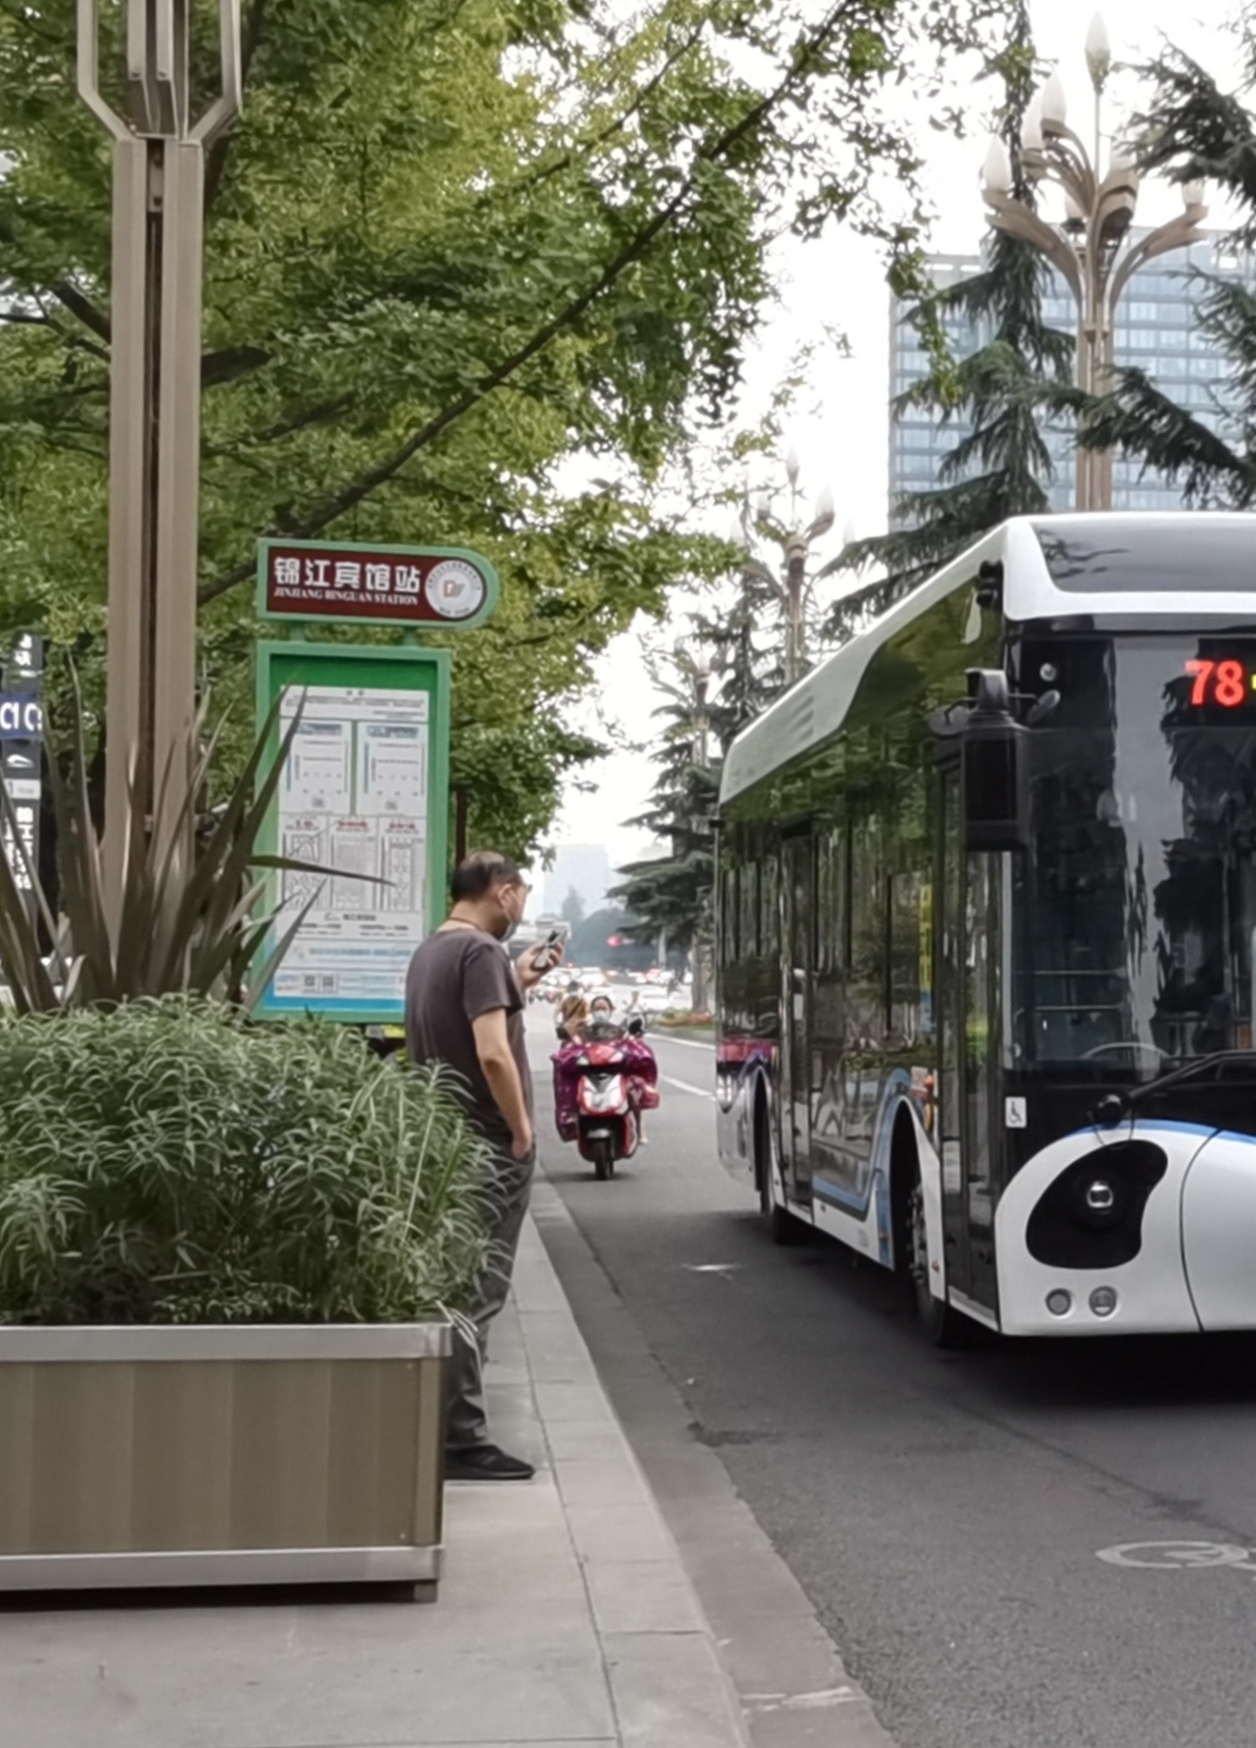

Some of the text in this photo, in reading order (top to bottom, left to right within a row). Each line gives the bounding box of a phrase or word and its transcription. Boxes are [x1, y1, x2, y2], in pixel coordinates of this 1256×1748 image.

[274, 557, 421, 593] 锦江宾馆站
[274, 587, 418, 606] JINJIANG BINGUAN STATION
[1185, 659, 1245, 706] 78
